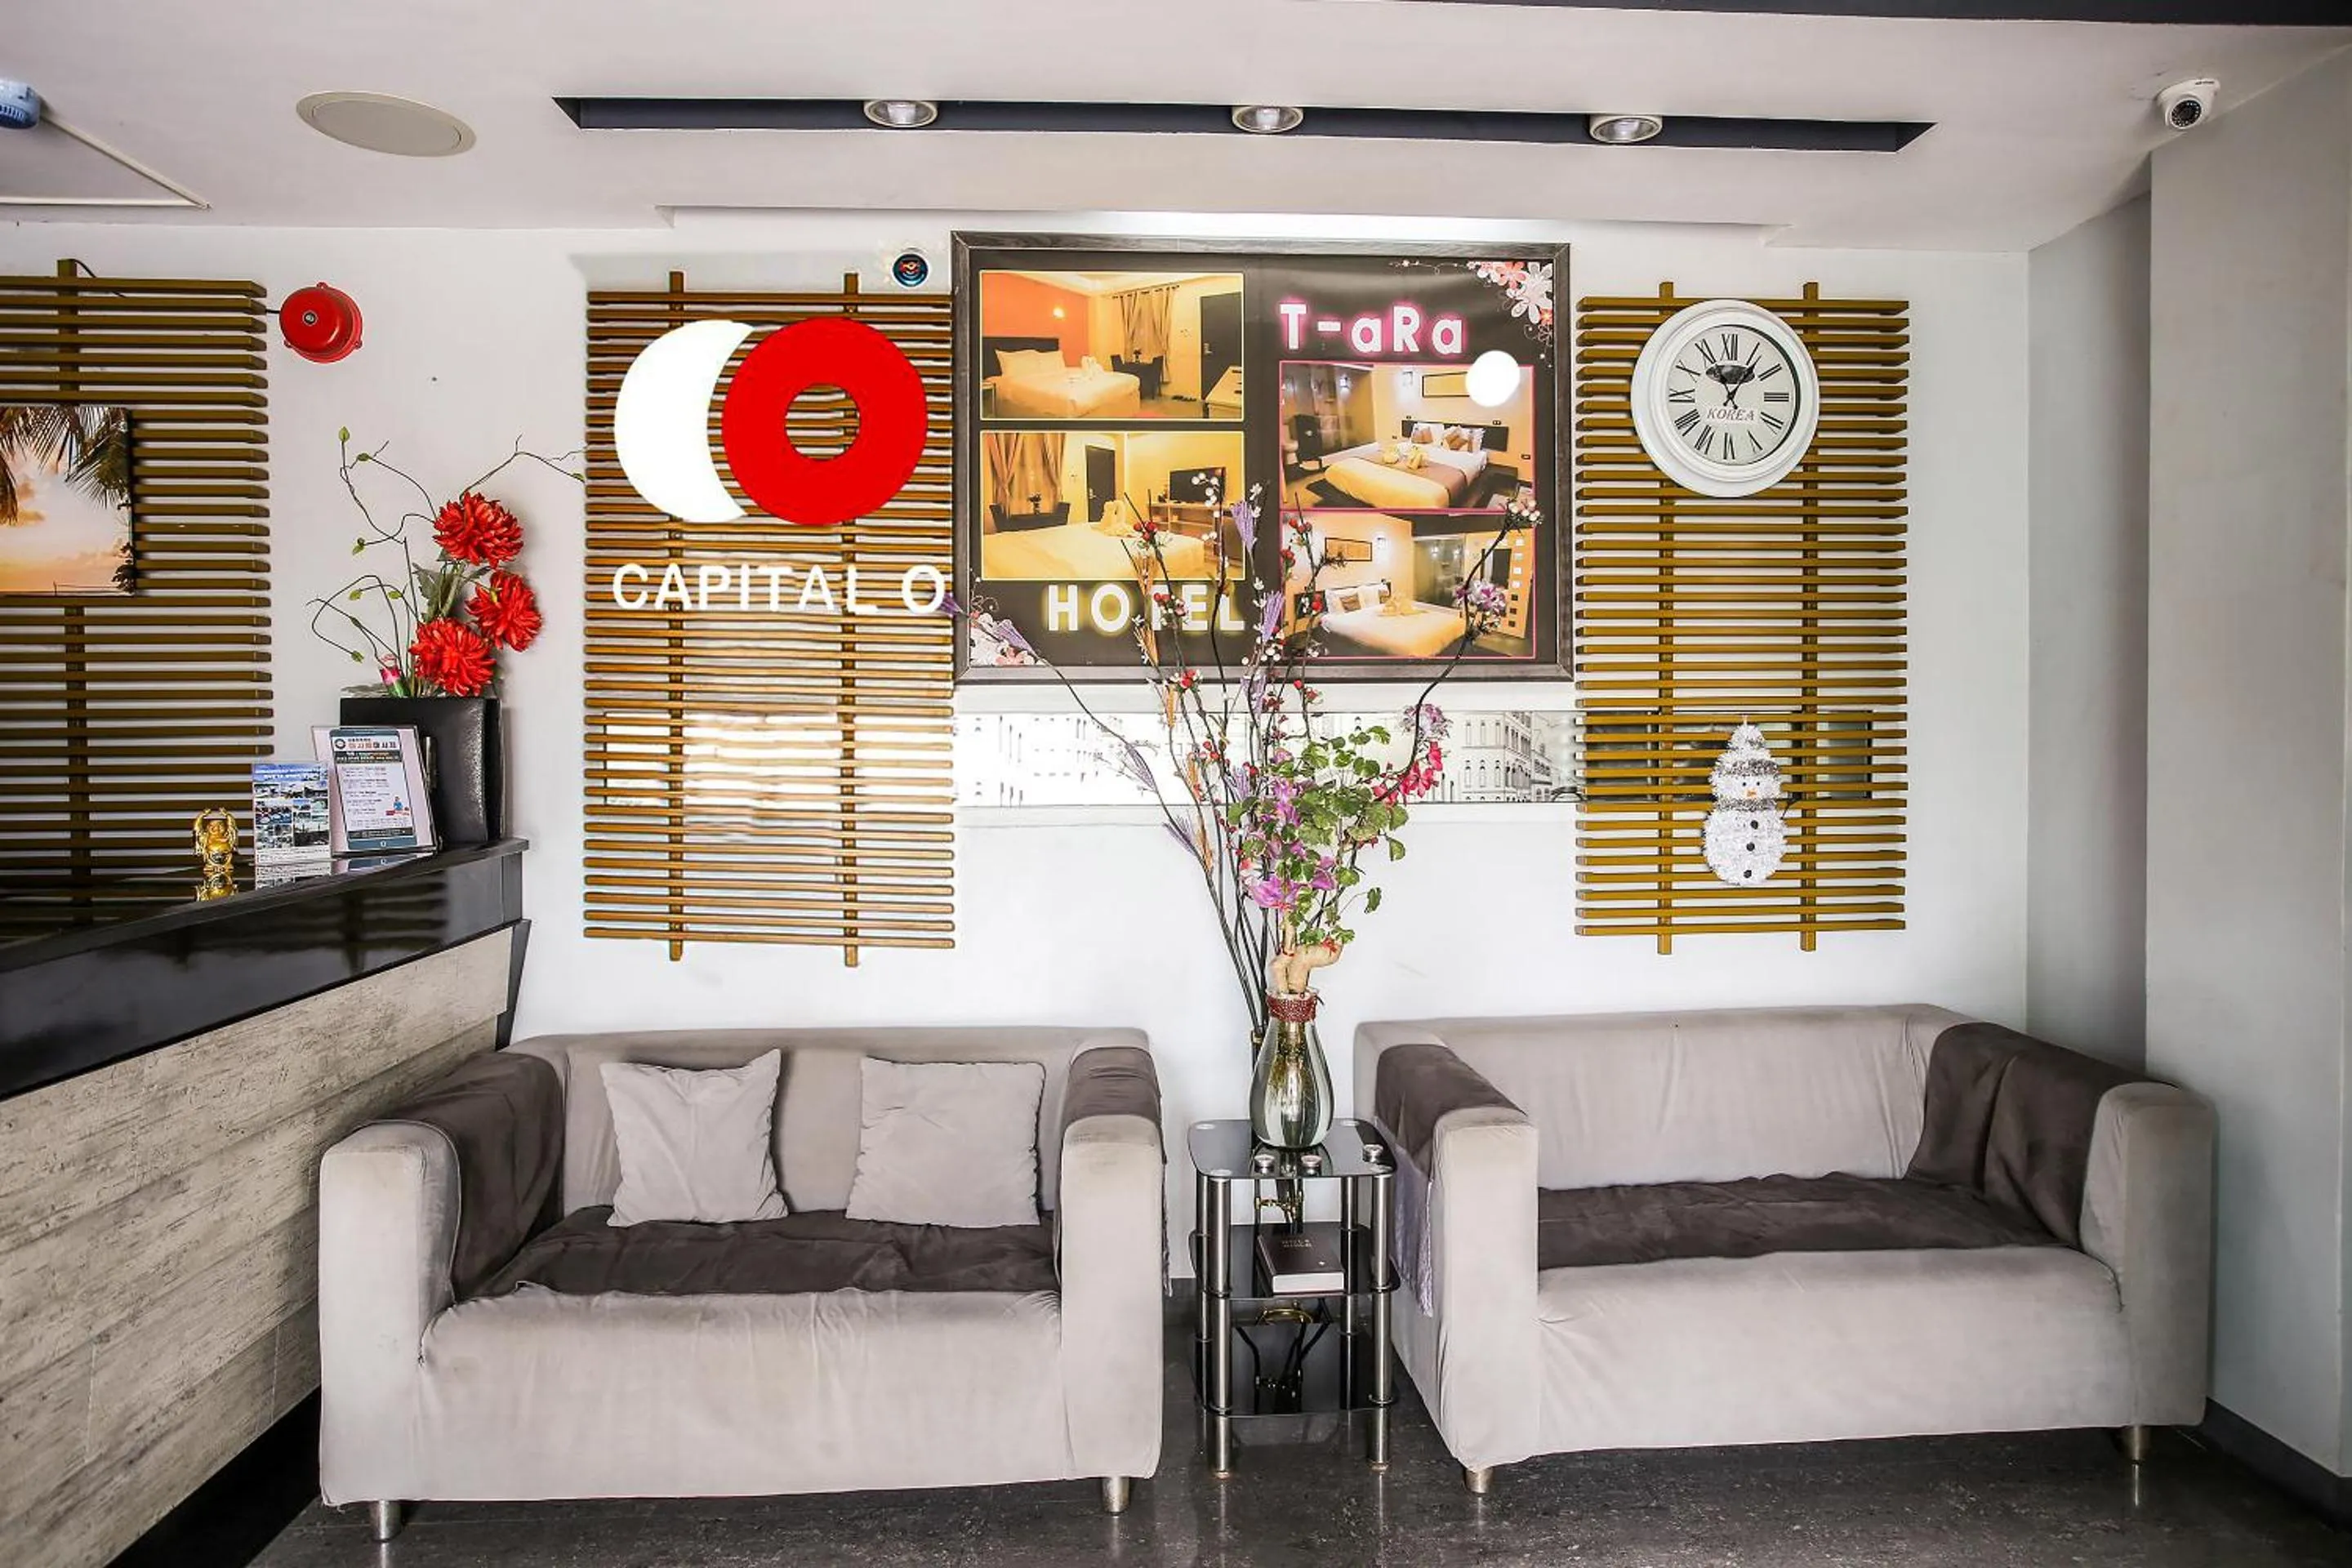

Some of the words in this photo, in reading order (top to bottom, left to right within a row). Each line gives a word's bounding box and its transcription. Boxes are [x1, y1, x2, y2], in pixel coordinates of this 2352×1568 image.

[1280, 303, 1463, 355] T-aRa
[1706, 407, 1756, 421] KOREA
[612, 563, 880, 612] CAPITAL
[901, 564, 946, 614] O
[1048, 583, 1246, 632] HOTEL
